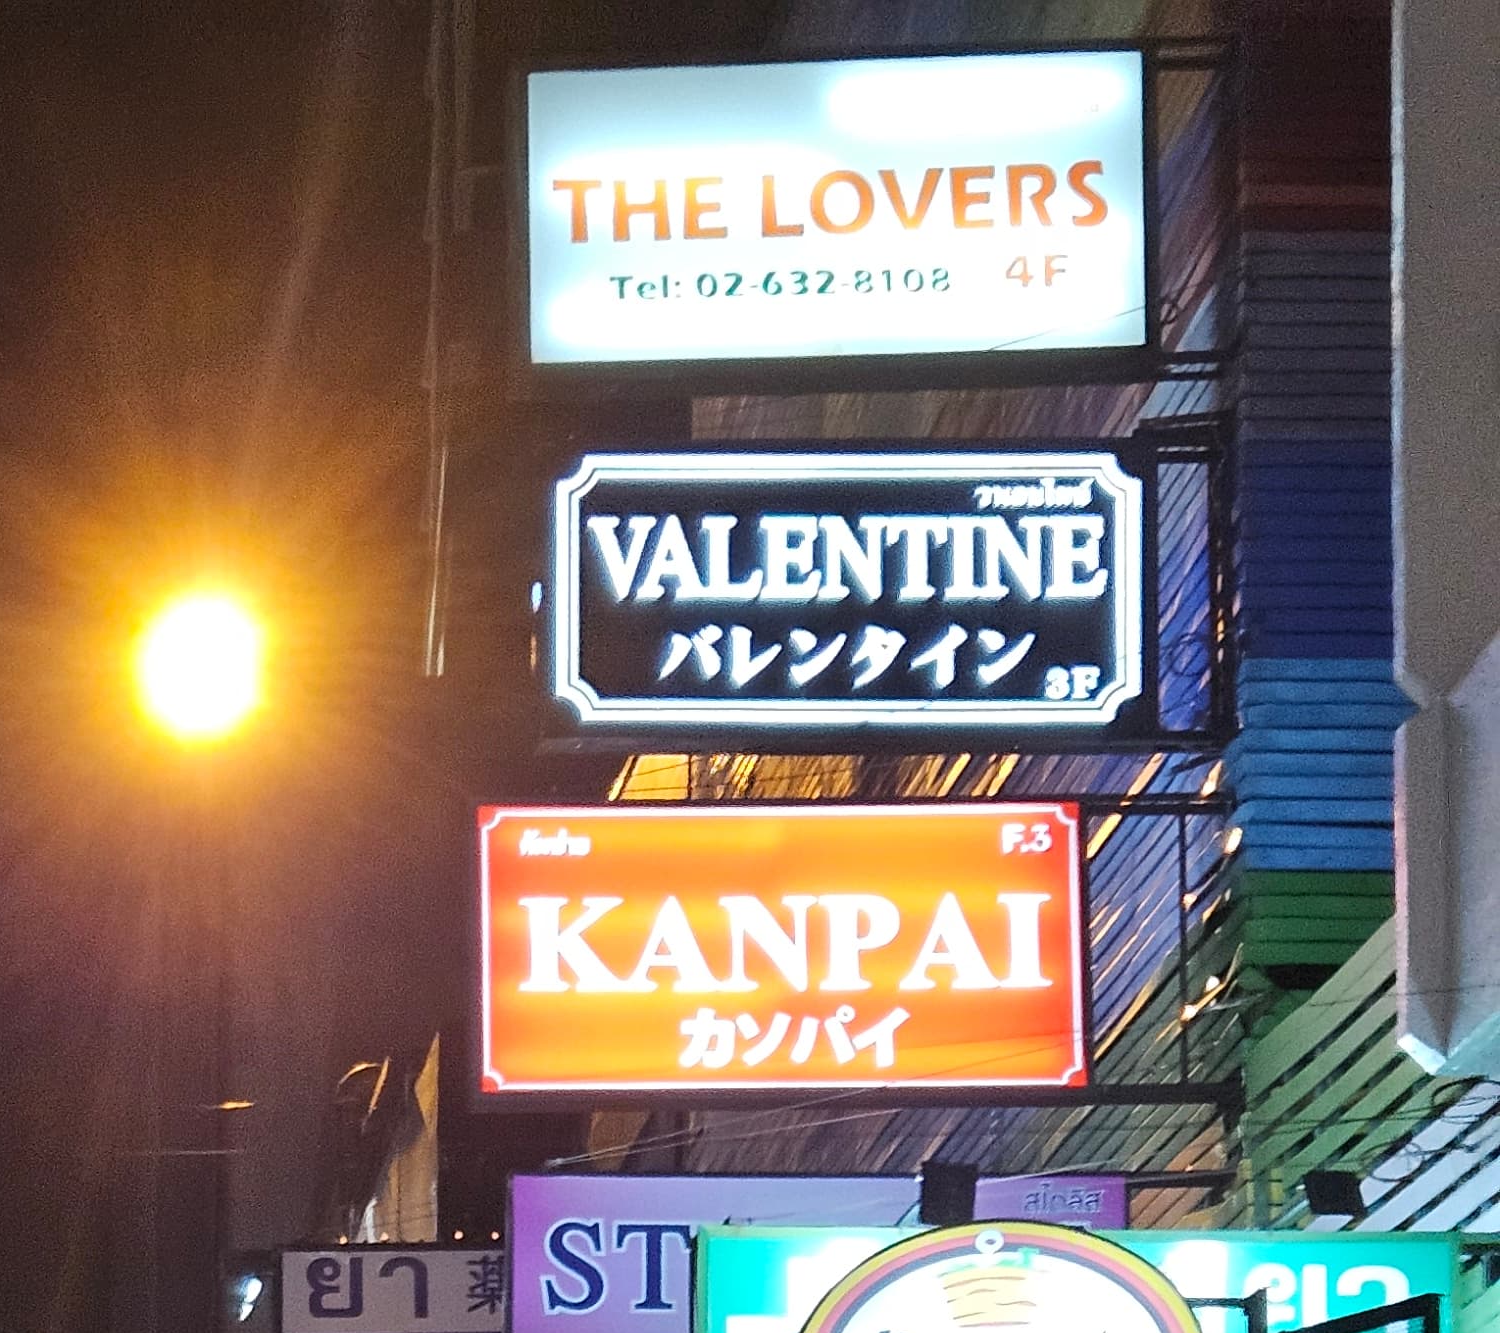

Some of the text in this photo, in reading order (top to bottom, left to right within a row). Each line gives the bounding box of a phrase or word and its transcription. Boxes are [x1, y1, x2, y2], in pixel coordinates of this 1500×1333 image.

[553, 160, 1109, 244] THE LOVERS
[610, 267, 952, 301] Tel: 02-632-8108
[587, 513, 1109, 602] VALENTINE
[657, 622, 1037, 689] バレンタイン
[518, 891, 1053, 995] KANPAI
[306, 1256, 429, 1319] ยา
